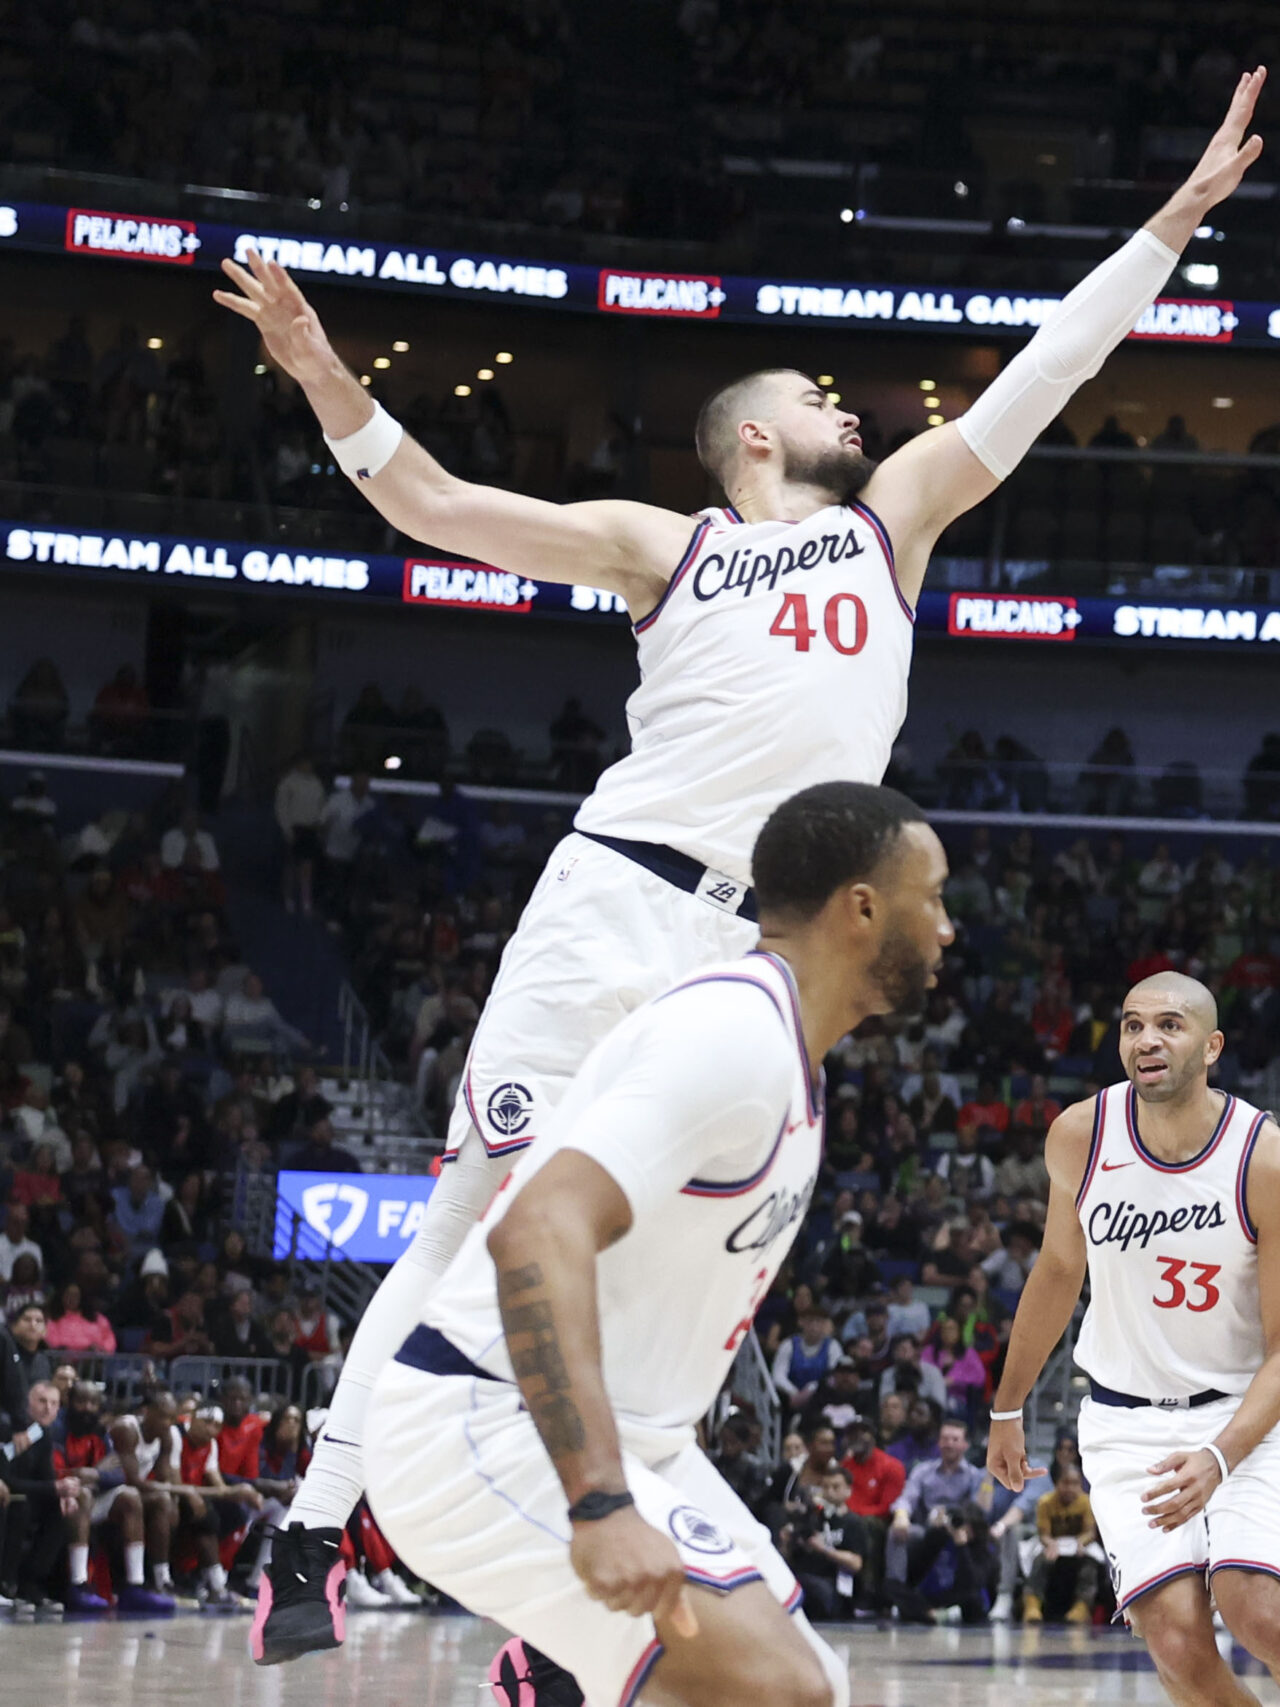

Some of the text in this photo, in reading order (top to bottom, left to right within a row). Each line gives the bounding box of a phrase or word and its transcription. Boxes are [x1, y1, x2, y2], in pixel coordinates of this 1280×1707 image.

[73, 215, 201, 258] PELICANS+
[234, 234, 568, 299] STREAM ALL GAMES
[605, 274, 727, 313] PELICANS+
[756, 284, 1063, 327] STREAM ALL GAME
[6, 529, 370, 591] STREAM ALL GAMES
[693, 528, 866, 602] Clippers
[410, 564, 539, 607] PELICANS+
[768, 592, 869, 656] 40
[956, 597, 1083, 636] PELICANS+
[1113, 605, 1257, 641] STREAM
[1089, 1201, 1226, 1252] Clippers
[1152, 1255, 1222, 1313] 33
